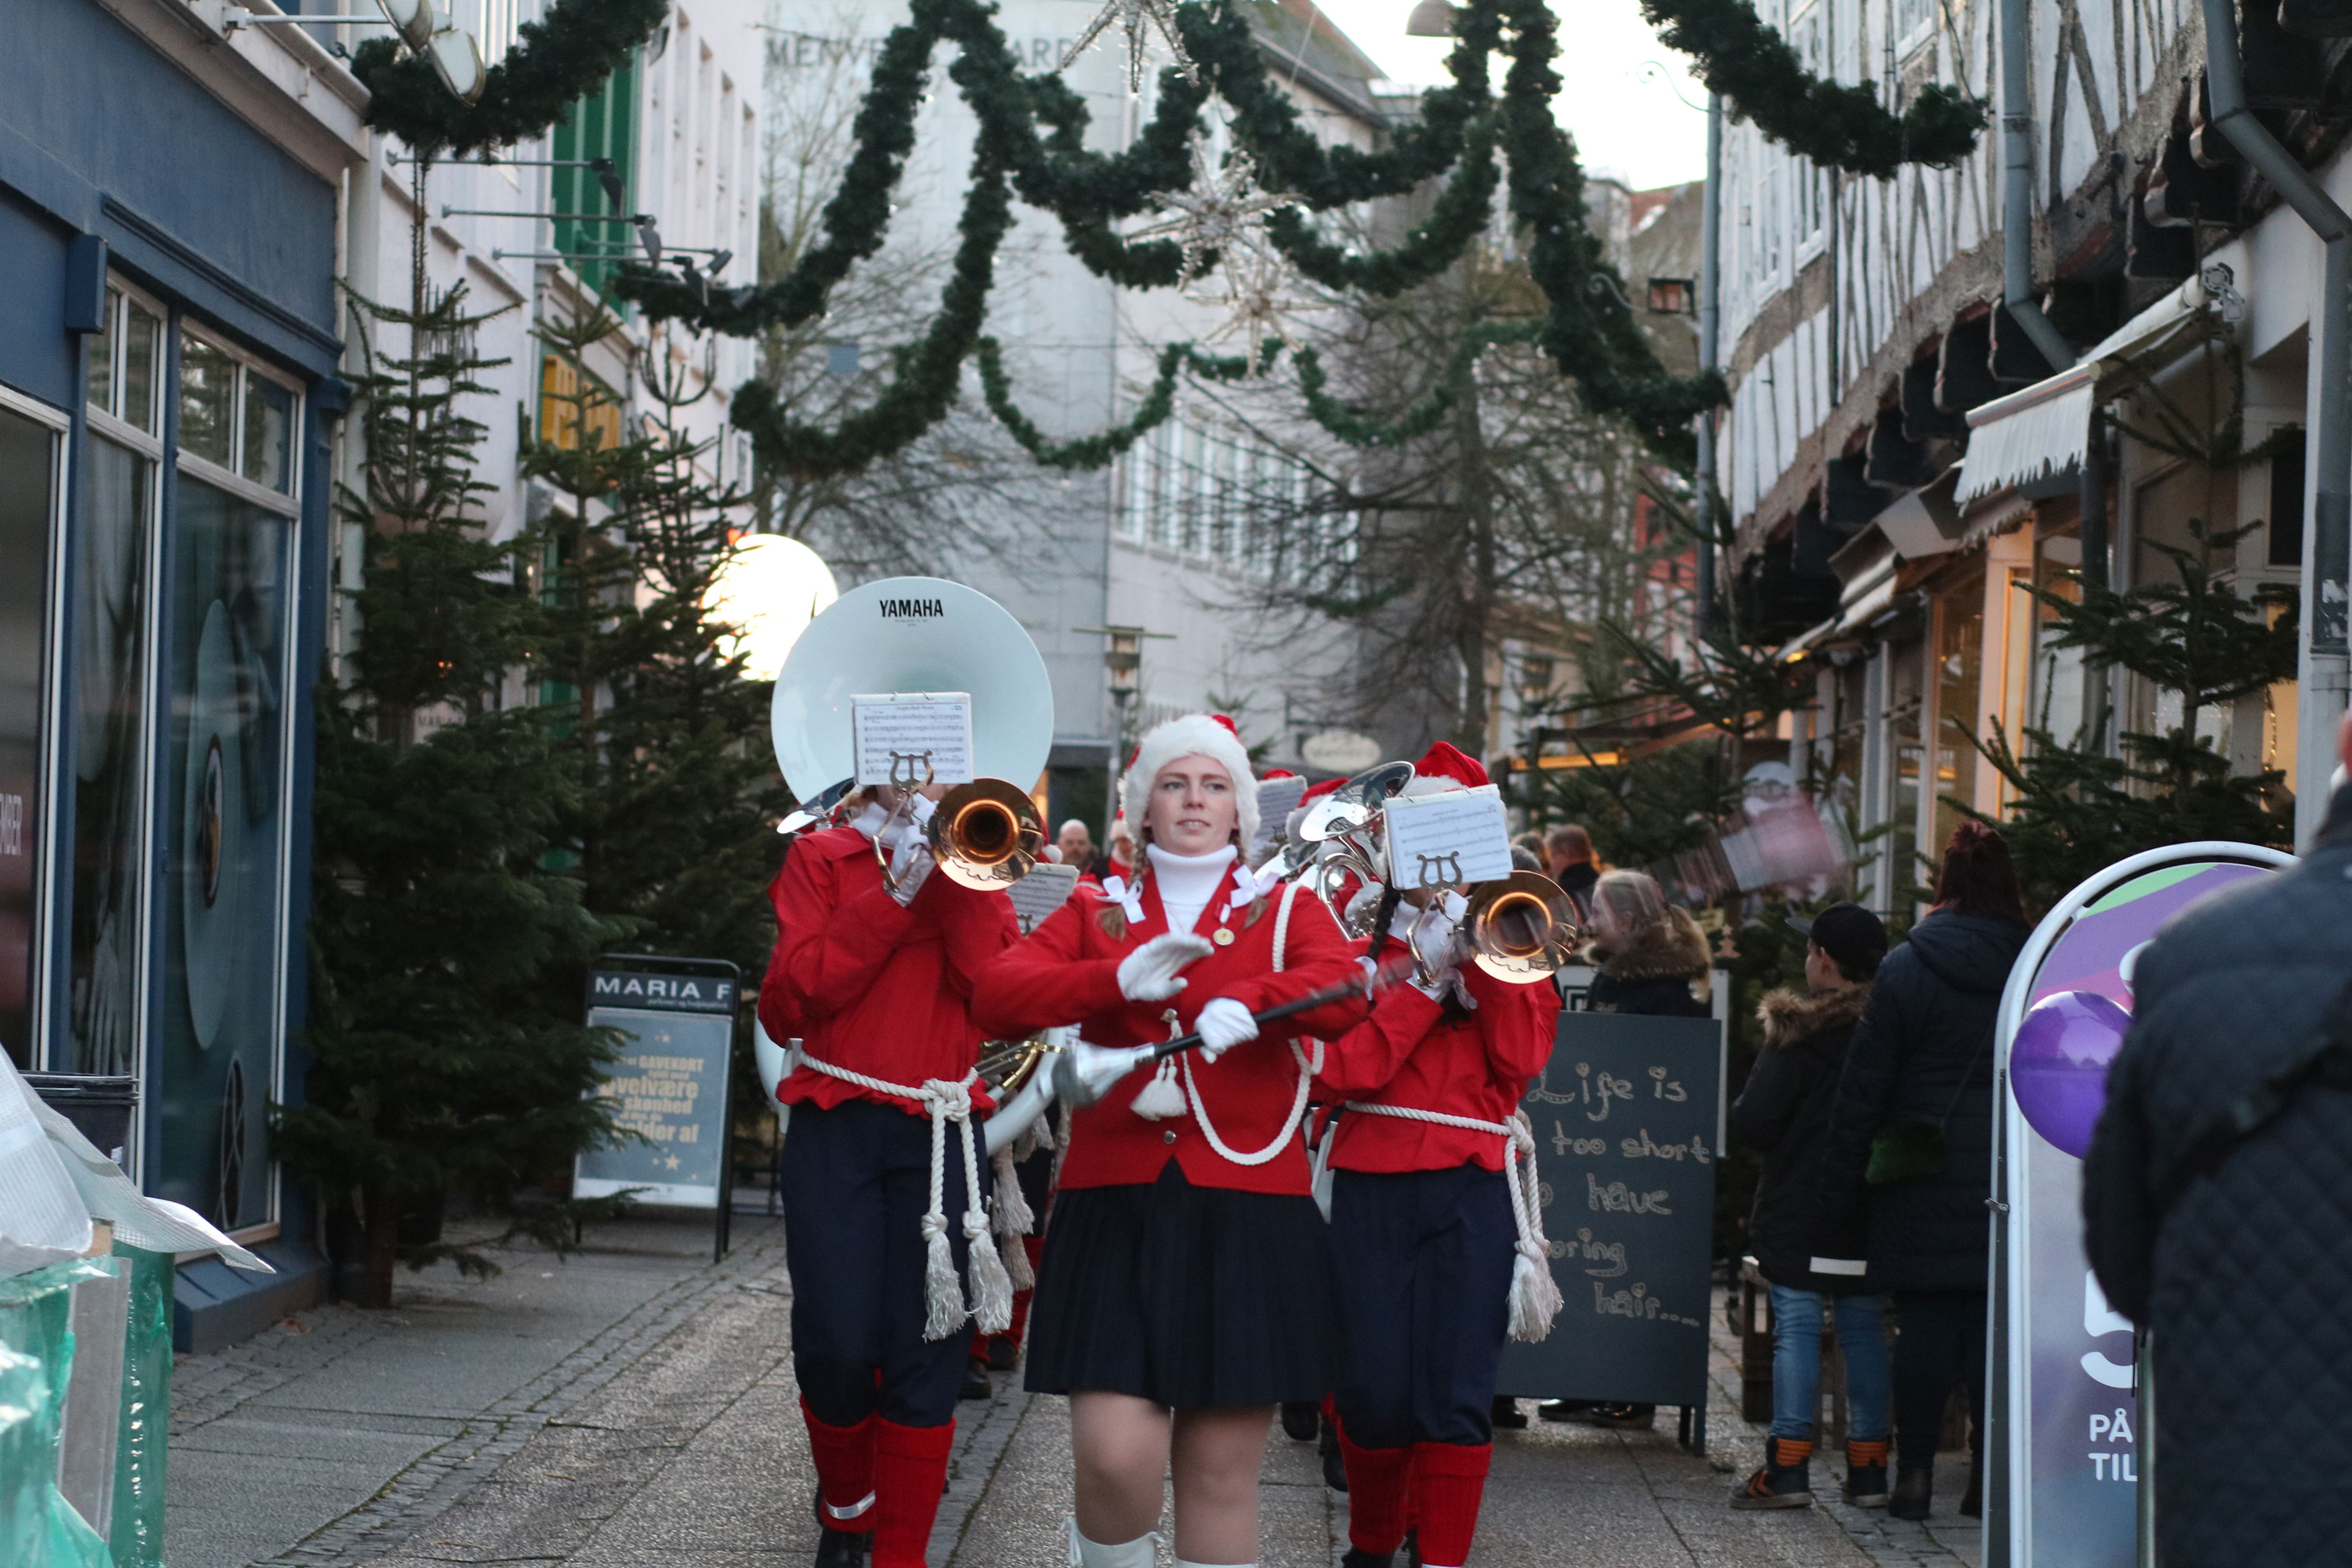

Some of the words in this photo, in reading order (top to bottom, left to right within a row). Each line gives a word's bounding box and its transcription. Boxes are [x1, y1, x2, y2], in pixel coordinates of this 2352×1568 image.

[879, 599, 944, 617] YAMAHA
[595, 976, 701, 998] MARIA
[717, 984, 732, 1000] F
[617, 1076, 699, 1099] velvære
[1526, 1063, 1635, 1121] Life
[1649, 1066, 1687, 1102] is
[679, 1123, 700, 1143] af
[1551, 1120, 1607, 1156] too
[1621, 1128, 1711, 1164] short
[1586, 1172, 1673, 1215] have
[1550, 1227, 1628, 1278] oring
[2089, 1408, 2134, 1444] PÅ
